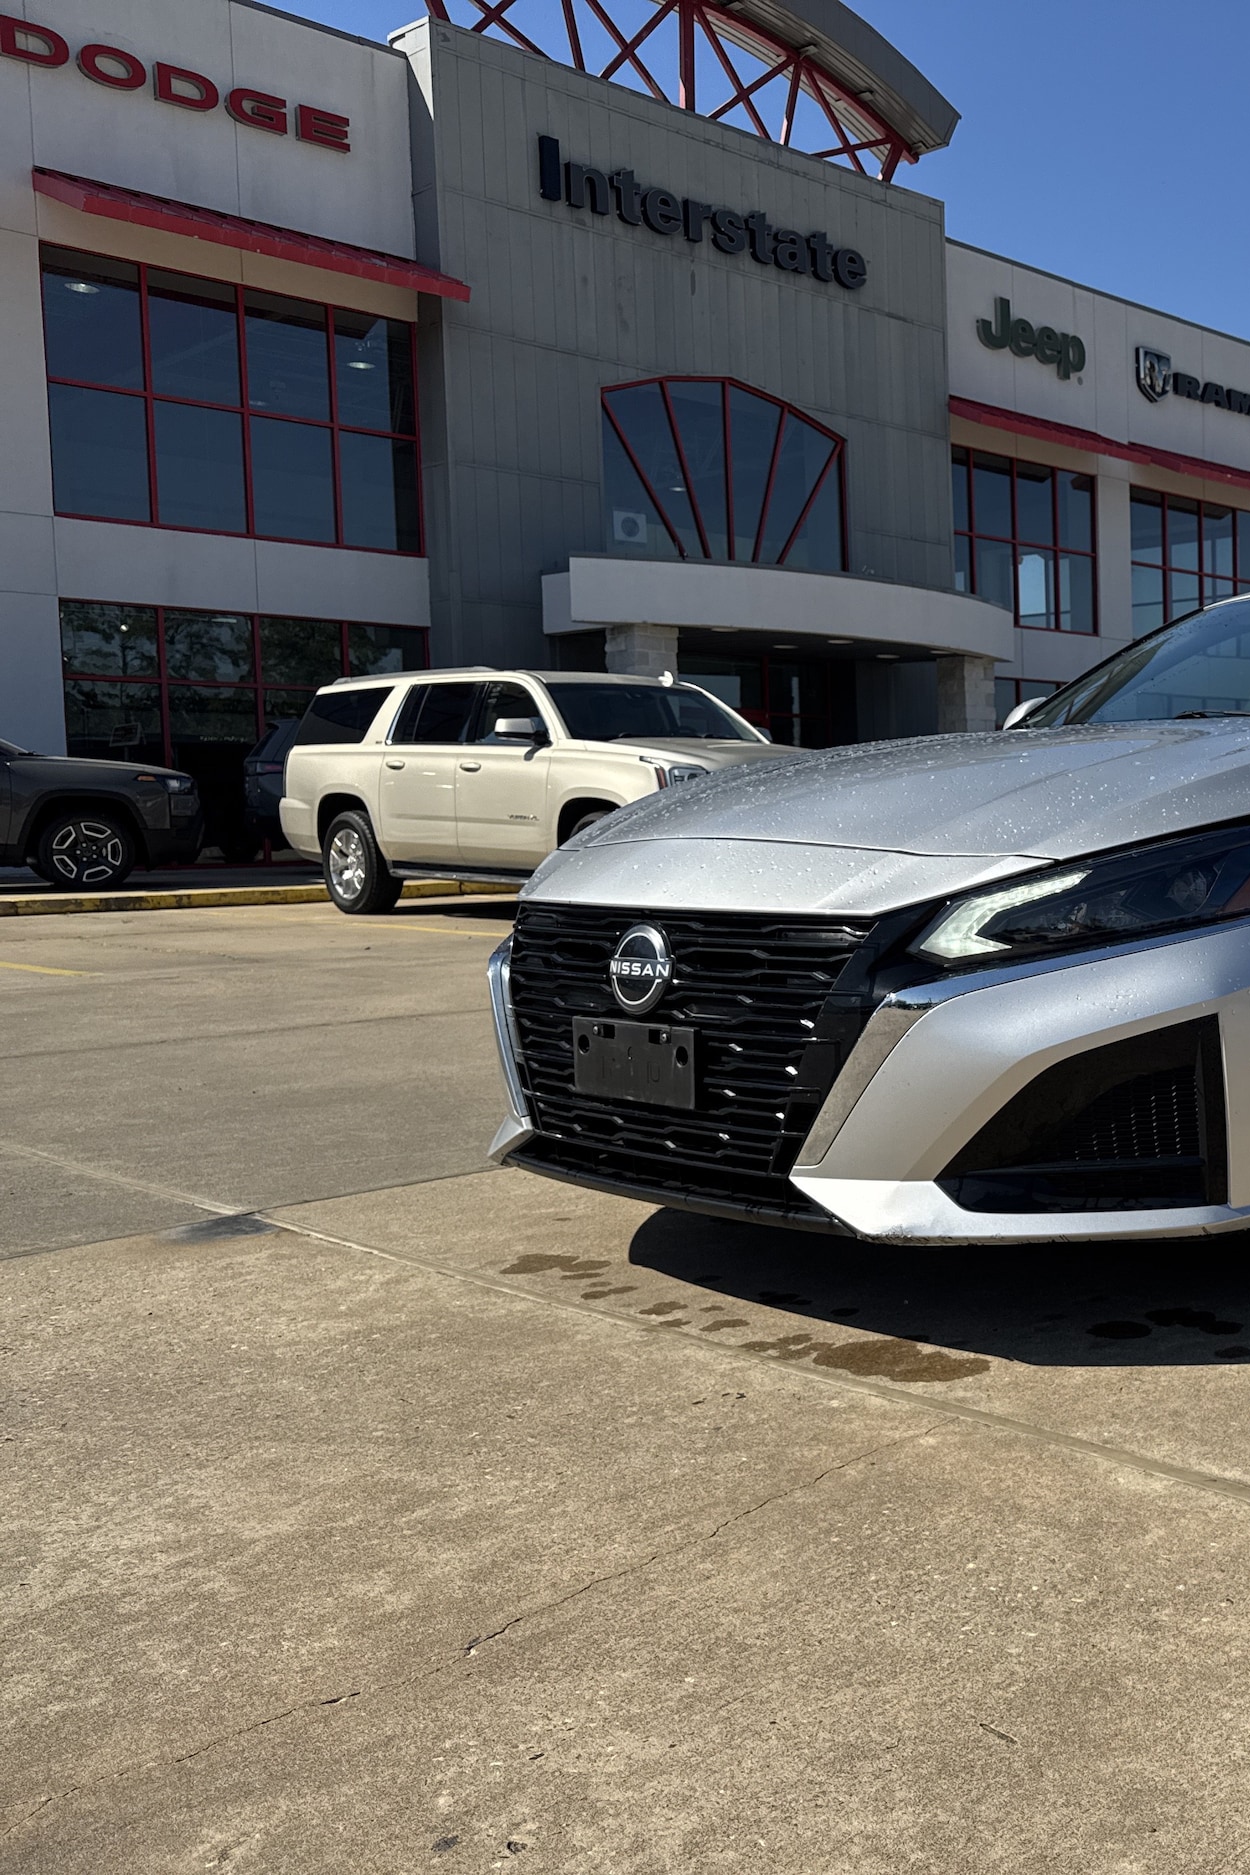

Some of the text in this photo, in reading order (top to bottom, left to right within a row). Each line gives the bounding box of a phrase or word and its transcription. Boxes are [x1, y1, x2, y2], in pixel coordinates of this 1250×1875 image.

[0, 14, 351, 153] DODGE
[538, 134, 868, 290] Interstate
[976, 297, 1086, 380] Jeep
[609, 960, 670, 977] NISSAN
